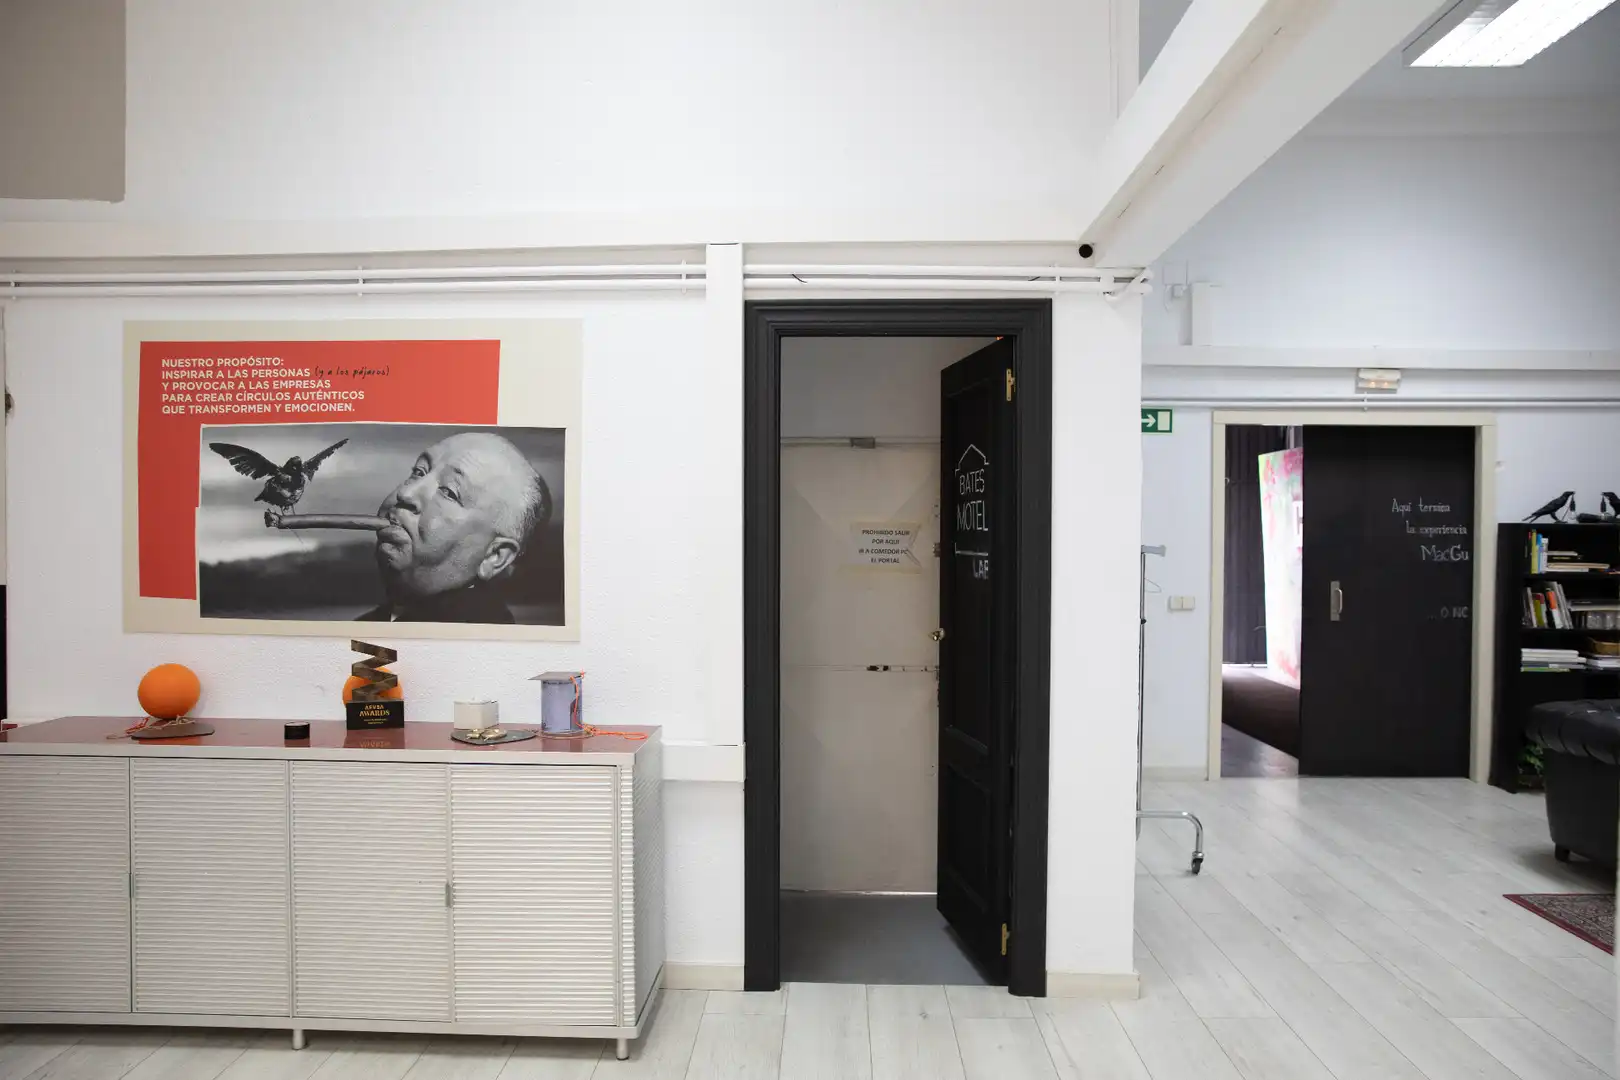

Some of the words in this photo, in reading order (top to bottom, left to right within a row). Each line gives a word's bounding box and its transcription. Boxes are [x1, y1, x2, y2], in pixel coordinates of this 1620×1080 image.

[162, 358, 214, 368] NUESTRO
[217, 356, 284, 367] PROPÓSITO:
[162, 370, 212, 379] INSPIRAR
[216, 370, 224, 378] A
[228, 370, 248, 378] LAS
[252, 368, 310, 378] PERSONAS
[336, 366, 348, 376] los
[162, 382, 169, 391] Y
[172, 382, 234, 390] PROVOCAR
[238, 382, 246, 390] A
[249, 380, 269, 390] LAS
[273, 380, 331, 389] EMPRESAS
[162, 394, 192, 402] PARA
[196, 393, 232, 402] CREAR
[236, 390, 291, 401] CÍRCULOS
[294, 388, 365, 401] AUTÉNTICOS
[162, 406, 185, 414] QUE
[188, 404, 271, 414] TRANSFORMEN
[274, 404, 281, 412] Y
[285, 403, 355, 413] EMOCIONEN.
[959, 468, 985, 495] BATES
[956, 500, 988, 531] MOTEL
[1420, 525, 1467, 538] experiencia
